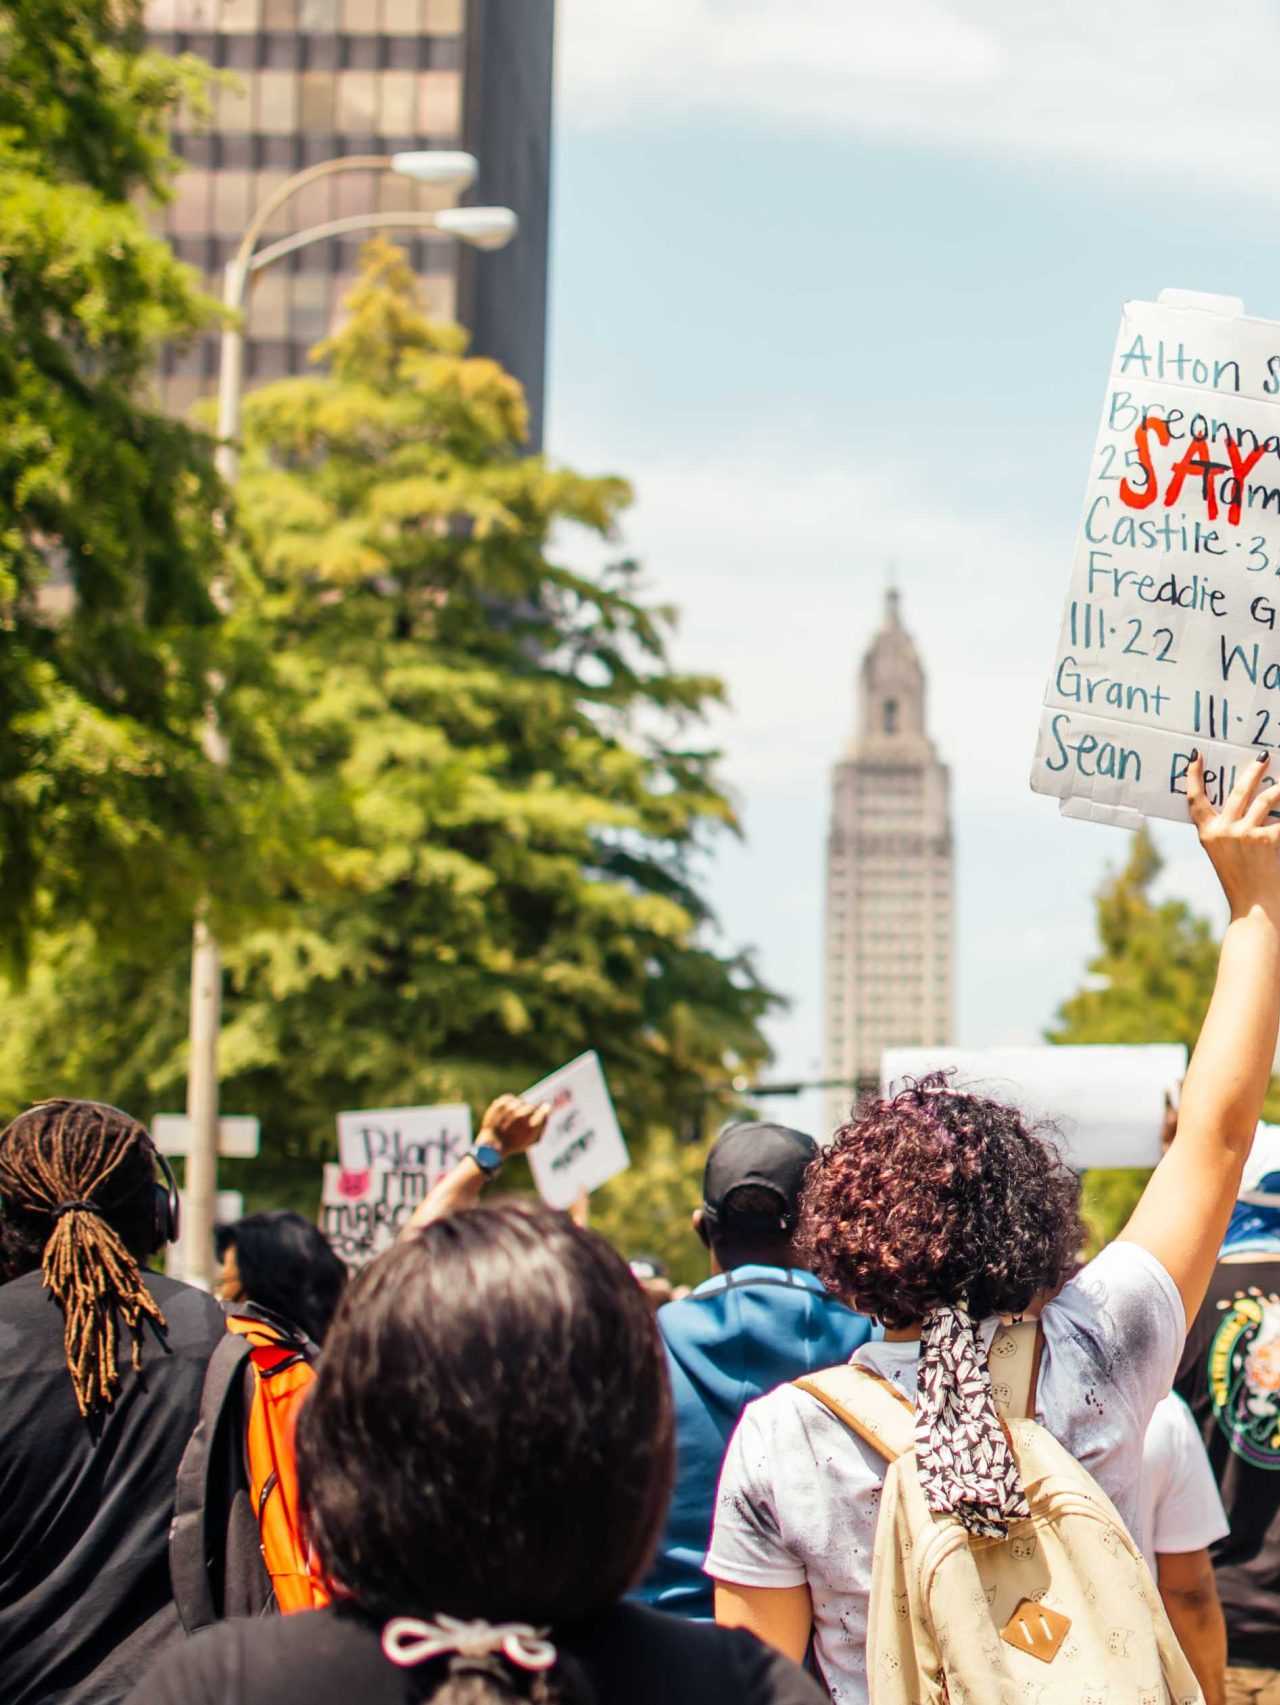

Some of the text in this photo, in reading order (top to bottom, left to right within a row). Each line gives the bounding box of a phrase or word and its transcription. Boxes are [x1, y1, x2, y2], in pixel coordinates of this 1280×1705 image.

[1120, 335, 1240, 392] Alton
[1098, 444, 1150, 487] 25
[1119, 416, 1272, 526] SAY
[1088, 551, 1227, 616] Freddie
[1056, 656, 1171, 715] Grant
[1046, 714, 1142, 782] Sean
